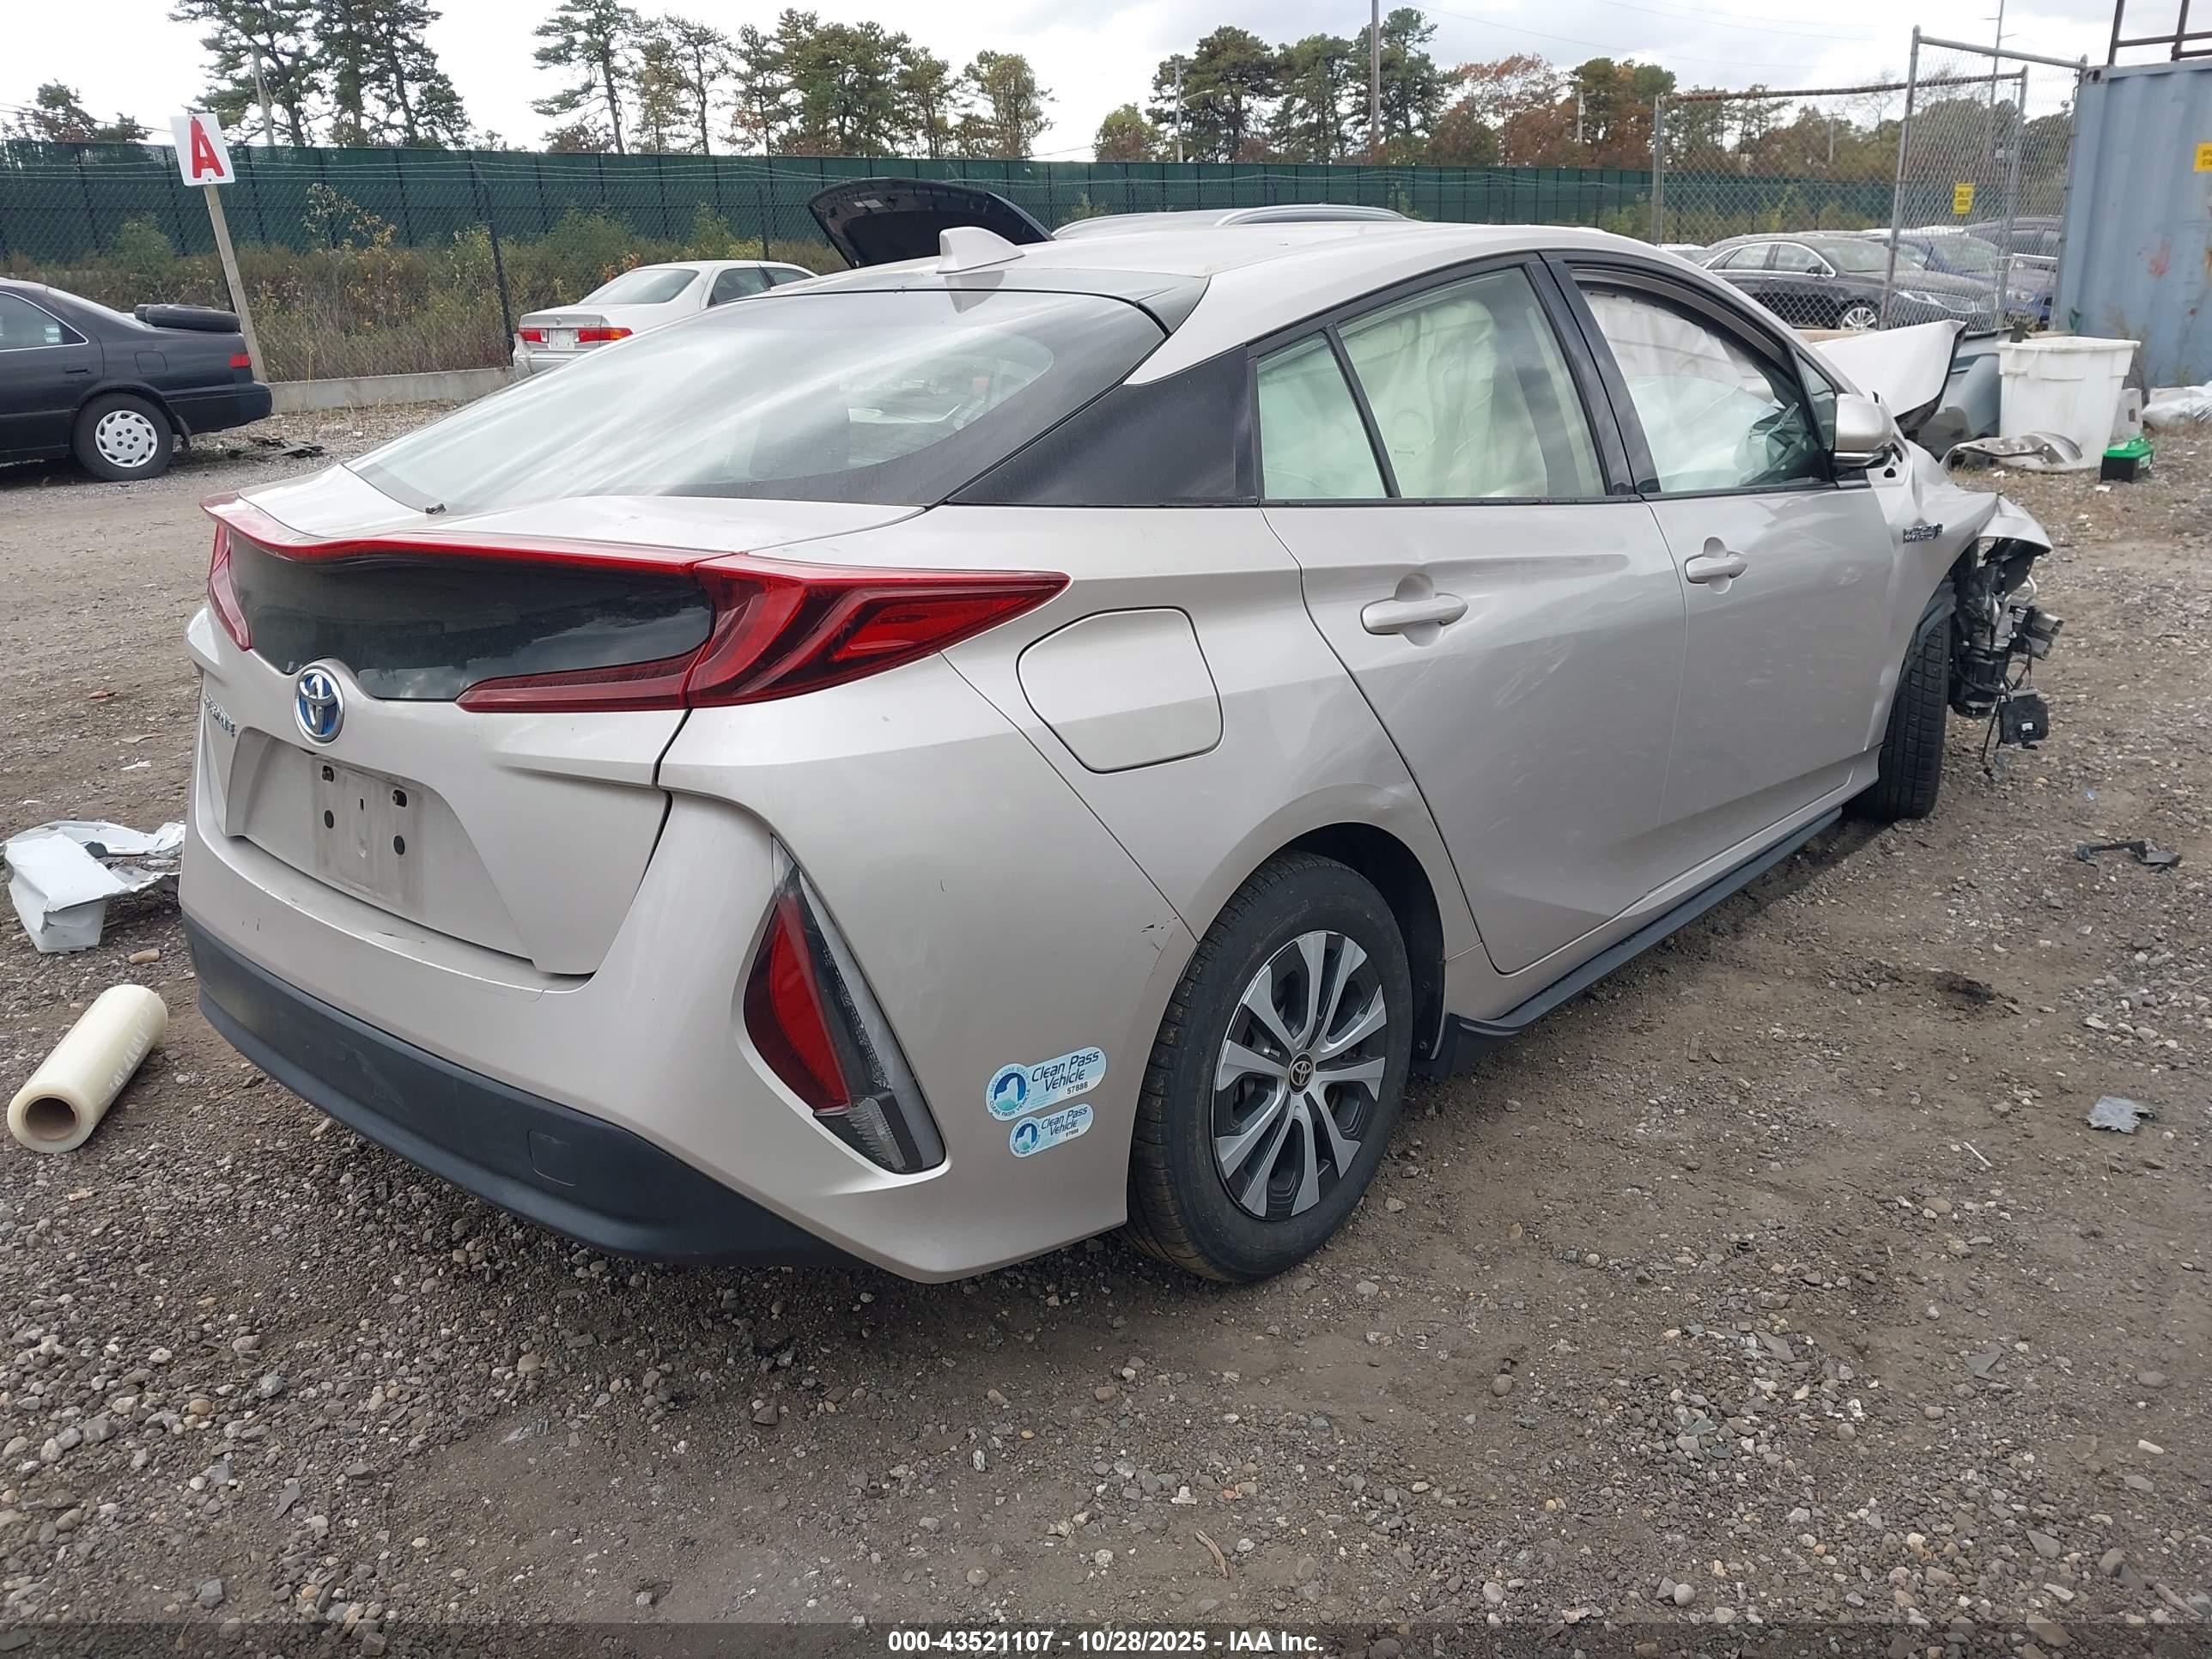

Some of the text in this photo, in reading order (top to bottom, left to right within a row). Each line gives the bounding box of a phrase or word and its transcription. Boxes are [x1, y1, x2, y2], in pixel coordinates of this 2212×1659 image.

[191, 118, 224, 179] A
[1031, 1050, 1100, 1083] Clean Pass
[1044, 1067, 1085, 1093] Vehicle
[1041, 1106, 1088, 1130] Clean Pass
[1050, 1119, 1079, 1137] Vehicle
